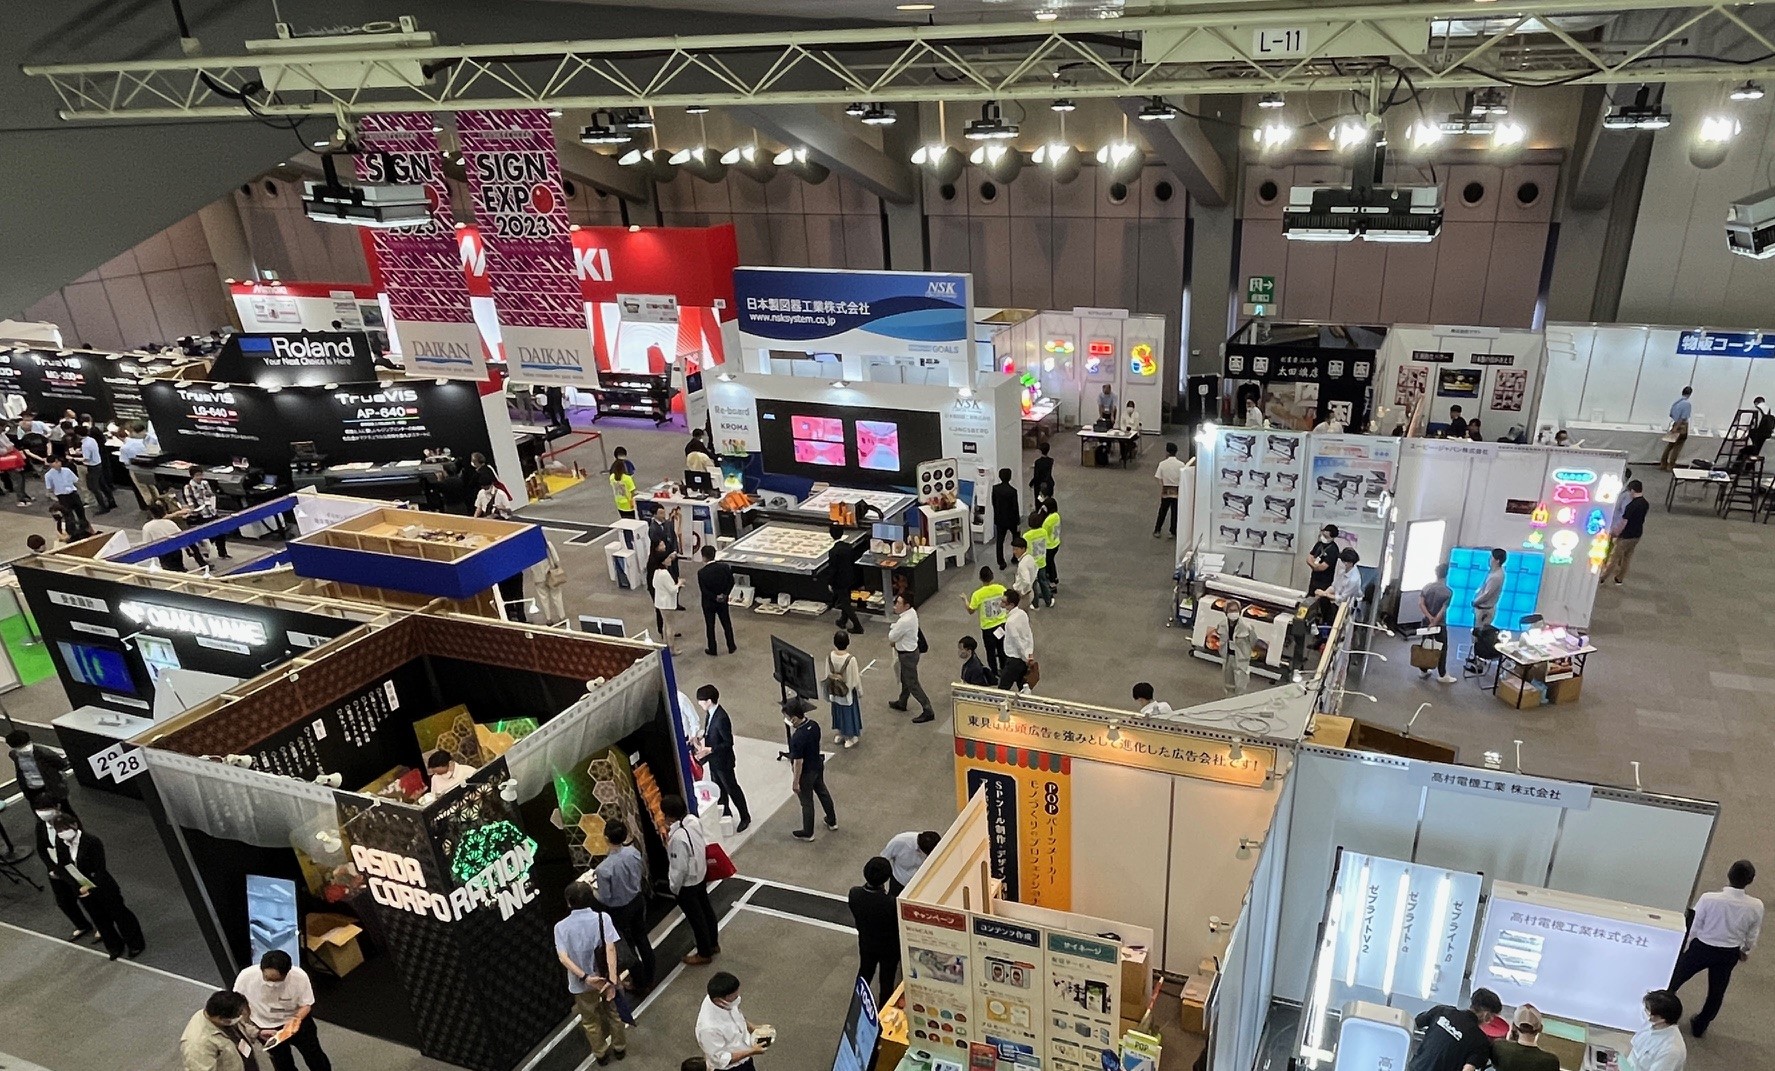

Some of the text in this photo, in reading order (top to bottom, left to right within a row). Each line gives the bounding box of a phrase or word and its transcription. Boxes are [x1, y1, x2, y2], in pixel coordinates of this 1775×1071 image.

[1260, 30, 1301, 53] L-11
[366, 152, 433, 183] SGN
[476, 153, 549, 184] SIGN
[496, 215, 551, 238] 2023
[927, 281, 957, 295] NSK
[746, 297, 871, 316] 日本製図器工業株式会社
[749, 312, 837, 327] www.nsksystem.co.jp
[272, 336, 355, 358] Roland
[412, 340, 471, 359] DAIKAN
[1681, 334, 1775, 353] 物販コーナー
[263, 357, 283, 366] Your
[283, 357, 300, 366] Next
[300, 357, 325, 366] Choice
[334, 357, 352, 366] Here
[517, 346, 580, 365] DAIKAN
[177, 389, 236, 404] TrueVIS
[334, 389, 419, 406] TrueVIS
[952, 397, 981, 410] NSK
[356, 406, 406, 419] AP-640
[720, 422, 749, 431] KROMA
[116, 756, 140, 777] 28
[1431, 771, 1562, 800] 高村電機工業 株式会社
[350, 843, 427, 888] ASIDA
[495, 872, 541, 922] INC.
[914, 910, 955, 925] キャンペーン
[980, 923, 1034, 942] コンテンツ作成
[1510, 911, 1650, 949] 高村電機工業株式会社
